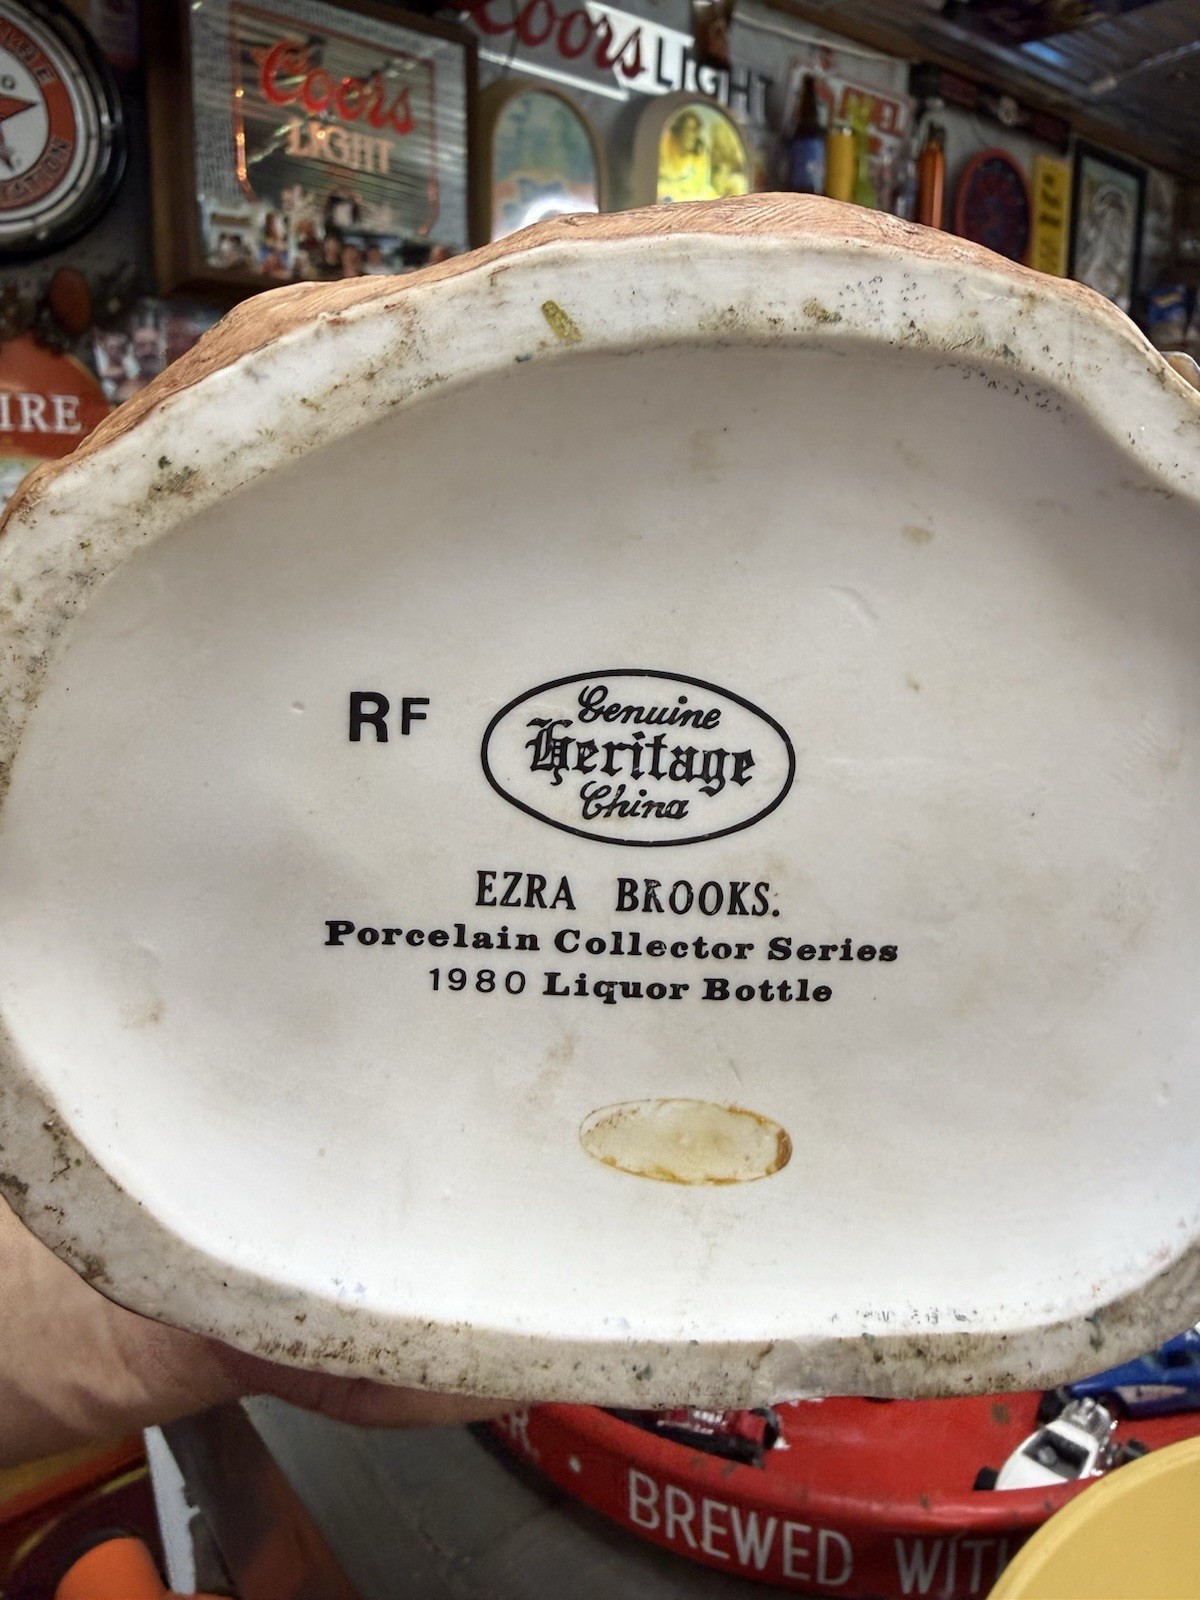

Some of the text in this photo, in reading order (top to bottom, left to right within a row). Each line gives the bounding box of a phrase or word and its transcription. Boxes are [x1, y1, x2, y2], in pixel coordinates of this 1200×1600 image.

[252, 40, 416, 135] Coors
[284, 116, 397, 174] LIGHT
[577, 684, 722, 730] Genuine
[525, 717, 756, 798] Heritage
[579, 780, 690, 821] China
[475, 870, 781, 918] EZRA BROOKS.
[324, 920, 898, 962] Porcelain Collector Series
[429, 967, 833, 1005] 1980 Liquor Bottle
[629, 1468, 853, 1585] BREWED
